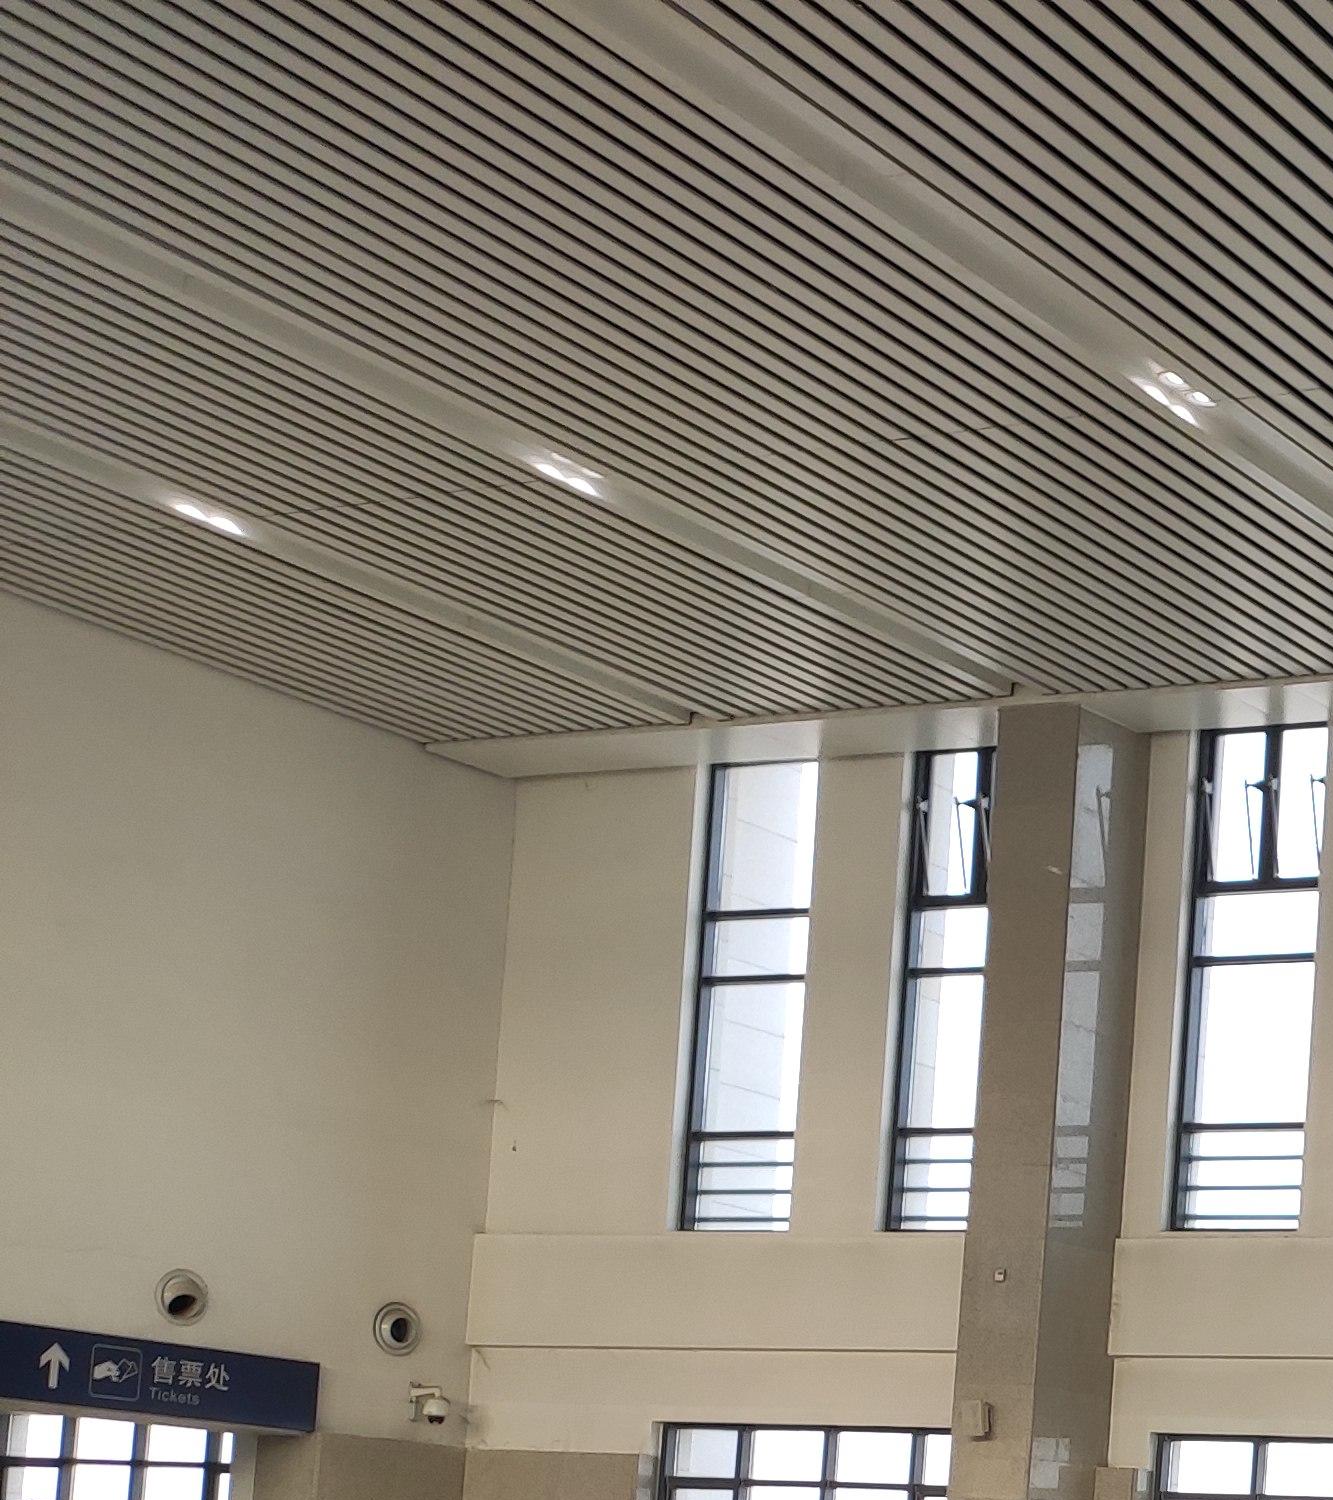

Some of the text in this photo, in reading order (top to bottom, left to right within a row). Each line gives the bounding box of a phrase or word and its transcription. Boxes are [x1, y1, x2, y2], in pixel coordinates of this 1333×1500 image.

[151, 1356, 230, 1391] 售票处
[149, 1386, 200, 1405] Tickets
